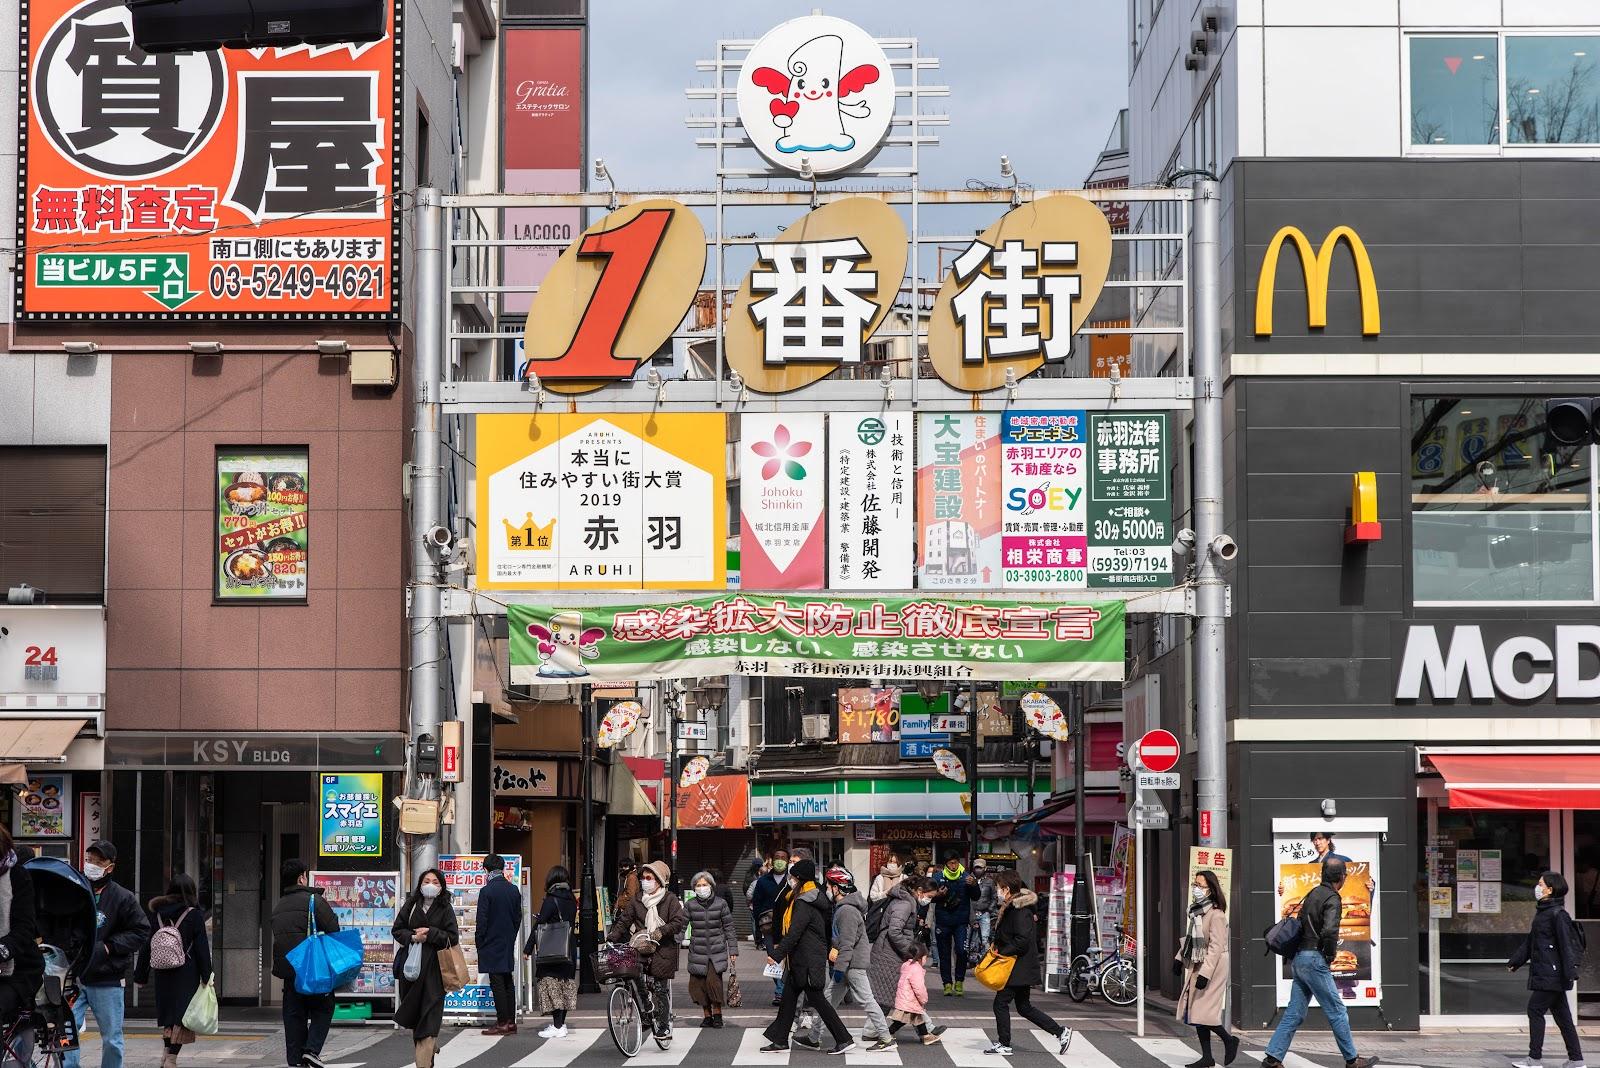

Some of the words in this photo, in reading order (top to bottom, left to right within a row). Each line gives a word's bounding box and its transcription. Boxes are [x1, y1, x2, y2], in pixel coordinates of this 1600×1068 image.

[228, 74, 380, 218] 屋
[33, 187, 217, 234] 無料査定
[514, 224, 571, 240] LACOCO
[212, 239, 383, 260] 南口側にもあります
[209, 265, 384, 298] 03-5249-4621
[1010, 416, 1078, 426] 地域密着不動産
[1097, 420, 1161, 447] 赤羽法律
[571, 449, 631, 467] 本当に
[1006, 446, 1082, 459] 赤羽エリアの
[933, 414, 964, 520] 大宝建設
[974, 415, 987, 520] 住まいのパートナー
[1010, 462, 1078, 476] 不動産なら
[1097, 448, 1160, 475] 事務所
[519, 470, 683, 489] 住みやすい街大賞
[580, 493, 622, 506] 2019
[761, 486, 803, 497] Johoku
[1006, 485, 1083, 512] SOEY
[761, 498, 803, 510] Shinkin
[755, 522, 809, 532] 城北信用金庫
[1094, 519, 1120, 540] 30分
[1123, 518, 1165, 540] 5000円
[510, 527, 549, 547] 第1位
[764, 538, 801, 547] 赤羽支店
[1028, 538, 1061, 547] 株式会社
[1006, 547, 1083, 565] 相栄商事
[1092, 556, 1168, 573] (5939)7194
[569, 564, 632, 576] ARUHI
[1006, 569, 1083, 582] 03-3903-2800
[1101, 574, 1158, 582] 一番街商店街入口
[611, 598, 1102, 642] 感染拡大防止徹底宣言
[24, 646, 58, 666] 24
[193, 741, 248, 762] KSY
[253, 750, 291, 763] BLDG
[905, 743, 917, 756] 酒
[325, 776, 336, 784] 6F
[1140, 776, 1178, 787] 自転車を除く
[324, 801, 379, 820] スマイエ
[778, 797, 828, 818] FamilyMart
[339, 819, 364, 828] 赤羽店
[340, 844, 378, 852] リノベーション
[1292, 849, 1315, 860] 楽しめ
[1197, 850, 1227, 867] 警告
